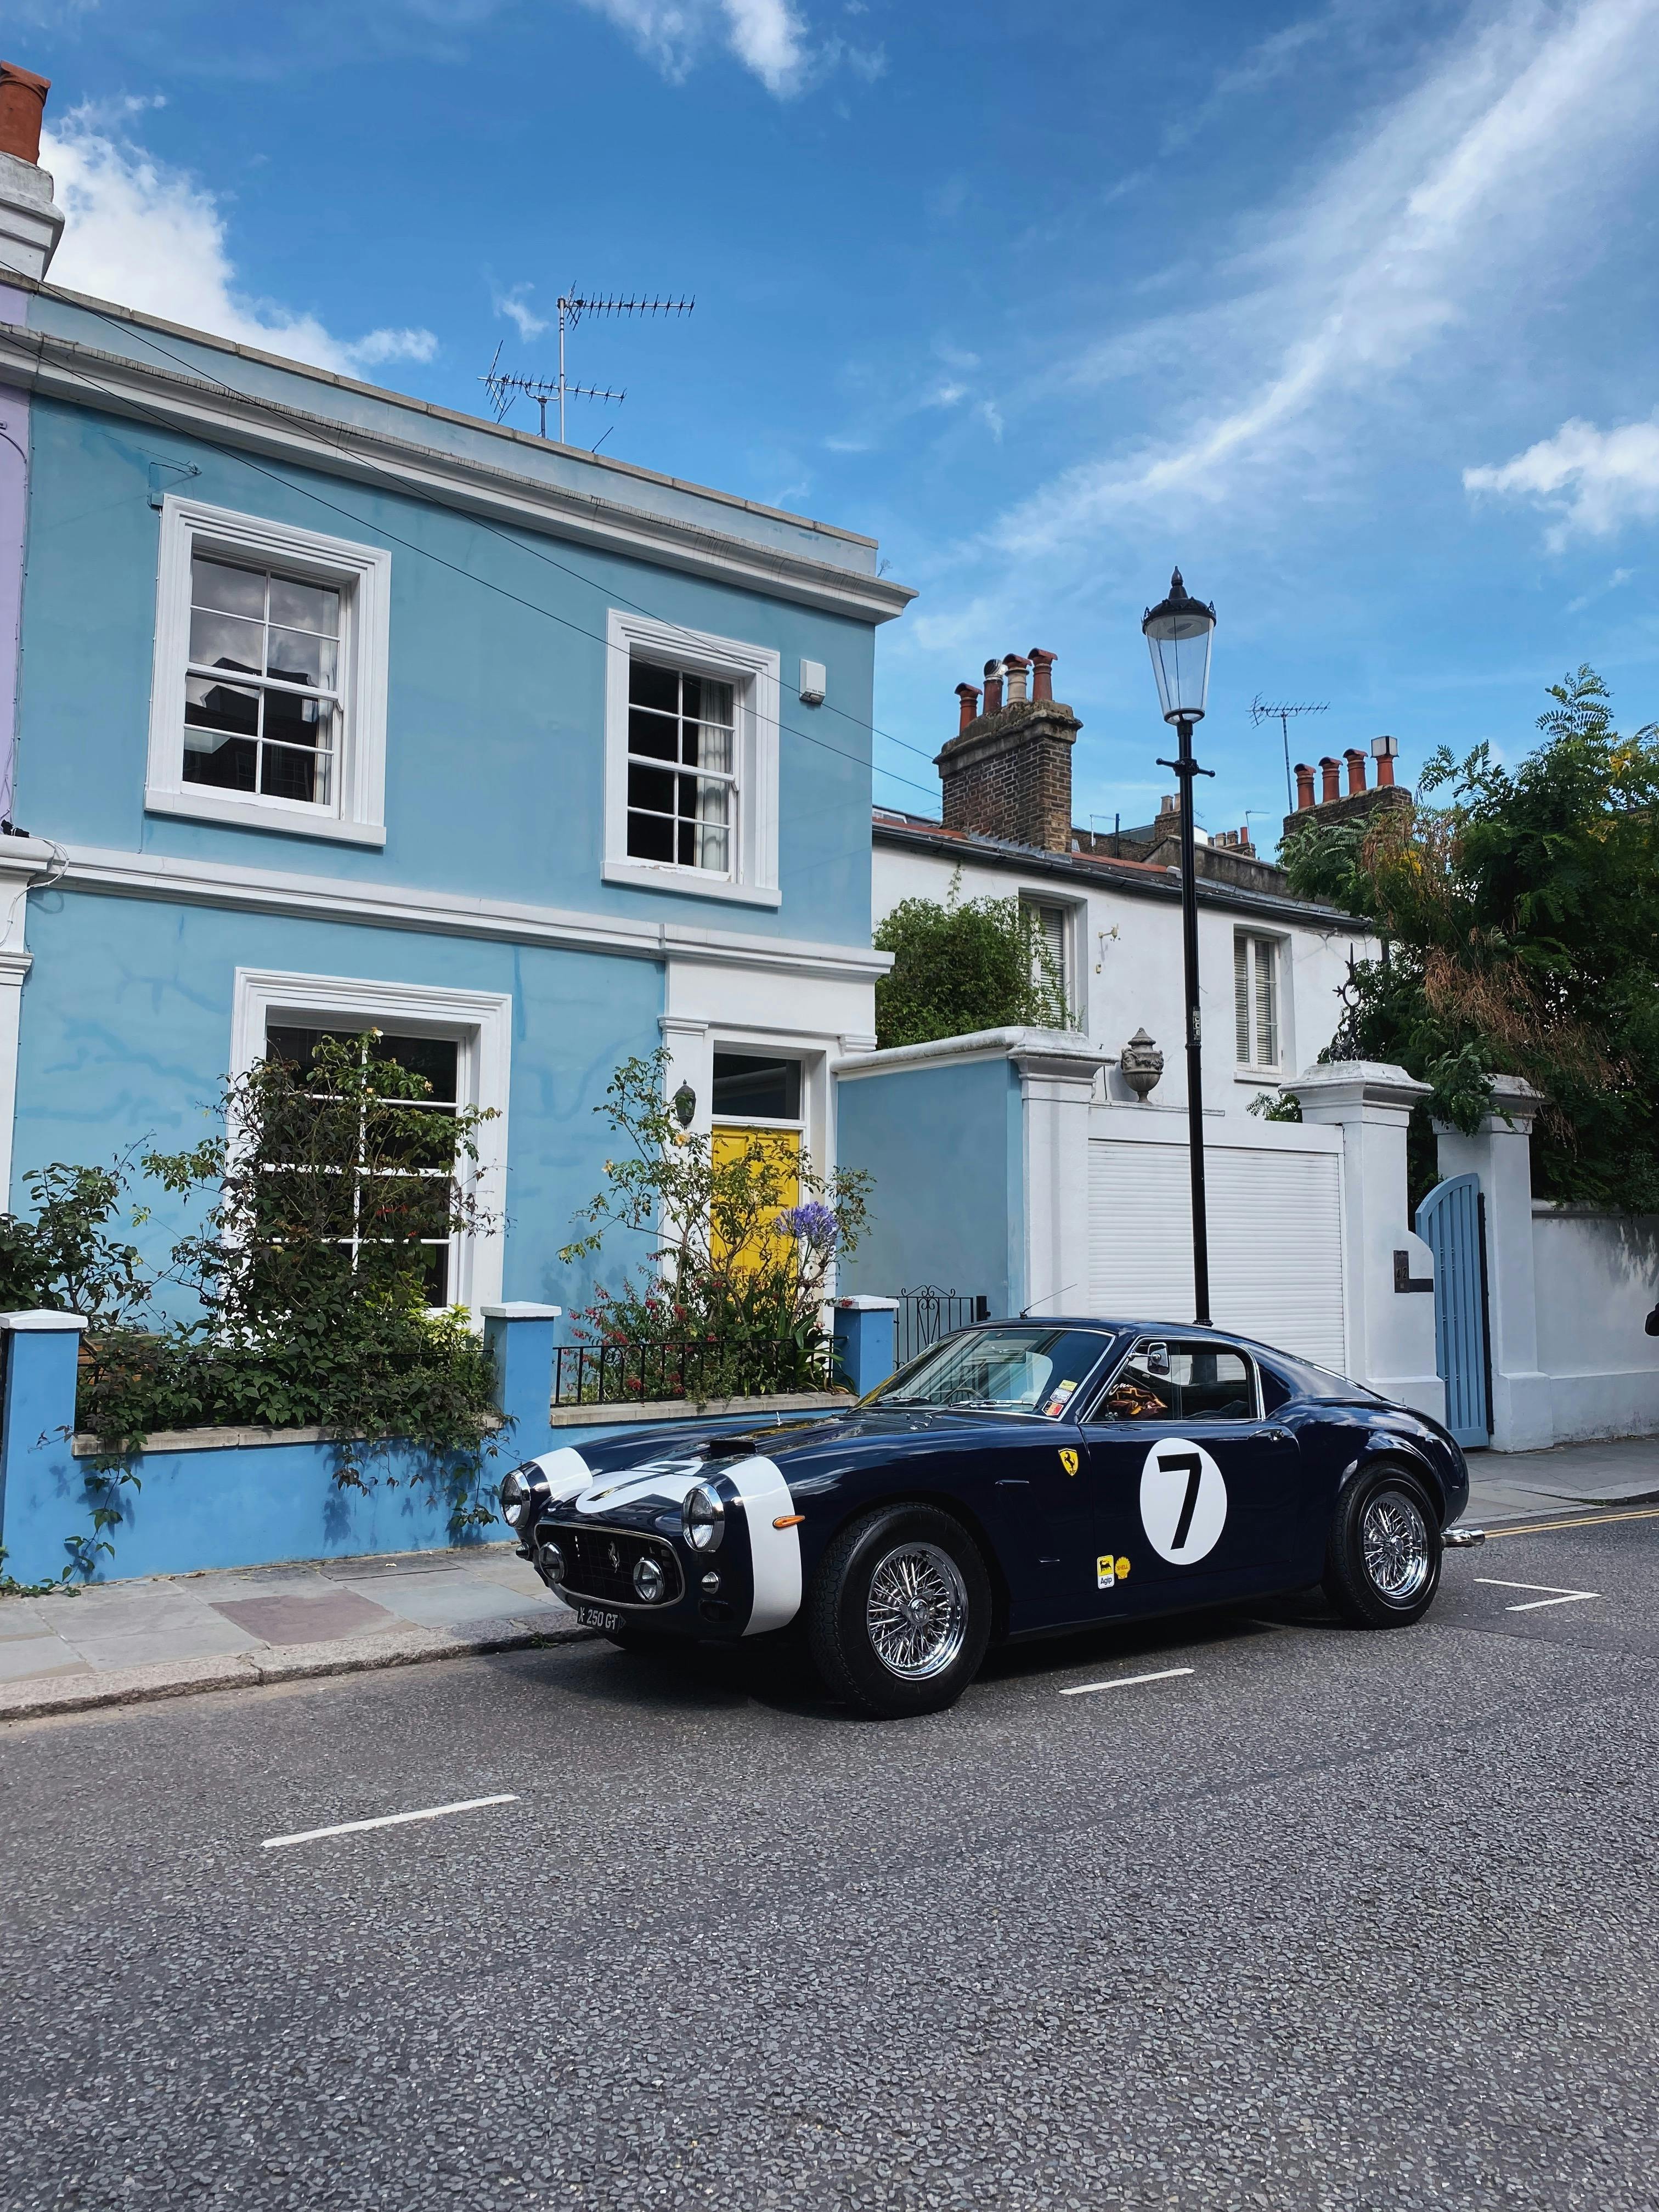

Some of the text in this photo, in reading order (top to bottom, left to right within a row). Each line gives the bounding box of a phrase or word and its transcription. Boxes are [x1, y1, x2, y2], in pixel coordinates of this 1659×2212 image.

[1396, 1267, 1407, 1280] 42
[586, 1464, 696, 1502] 7
[1157, 1453, 1203, 1550] 7
[1101, 1576, 1112, 1585] Agip
[578, 1606, 618, 1630] X 250 GT
